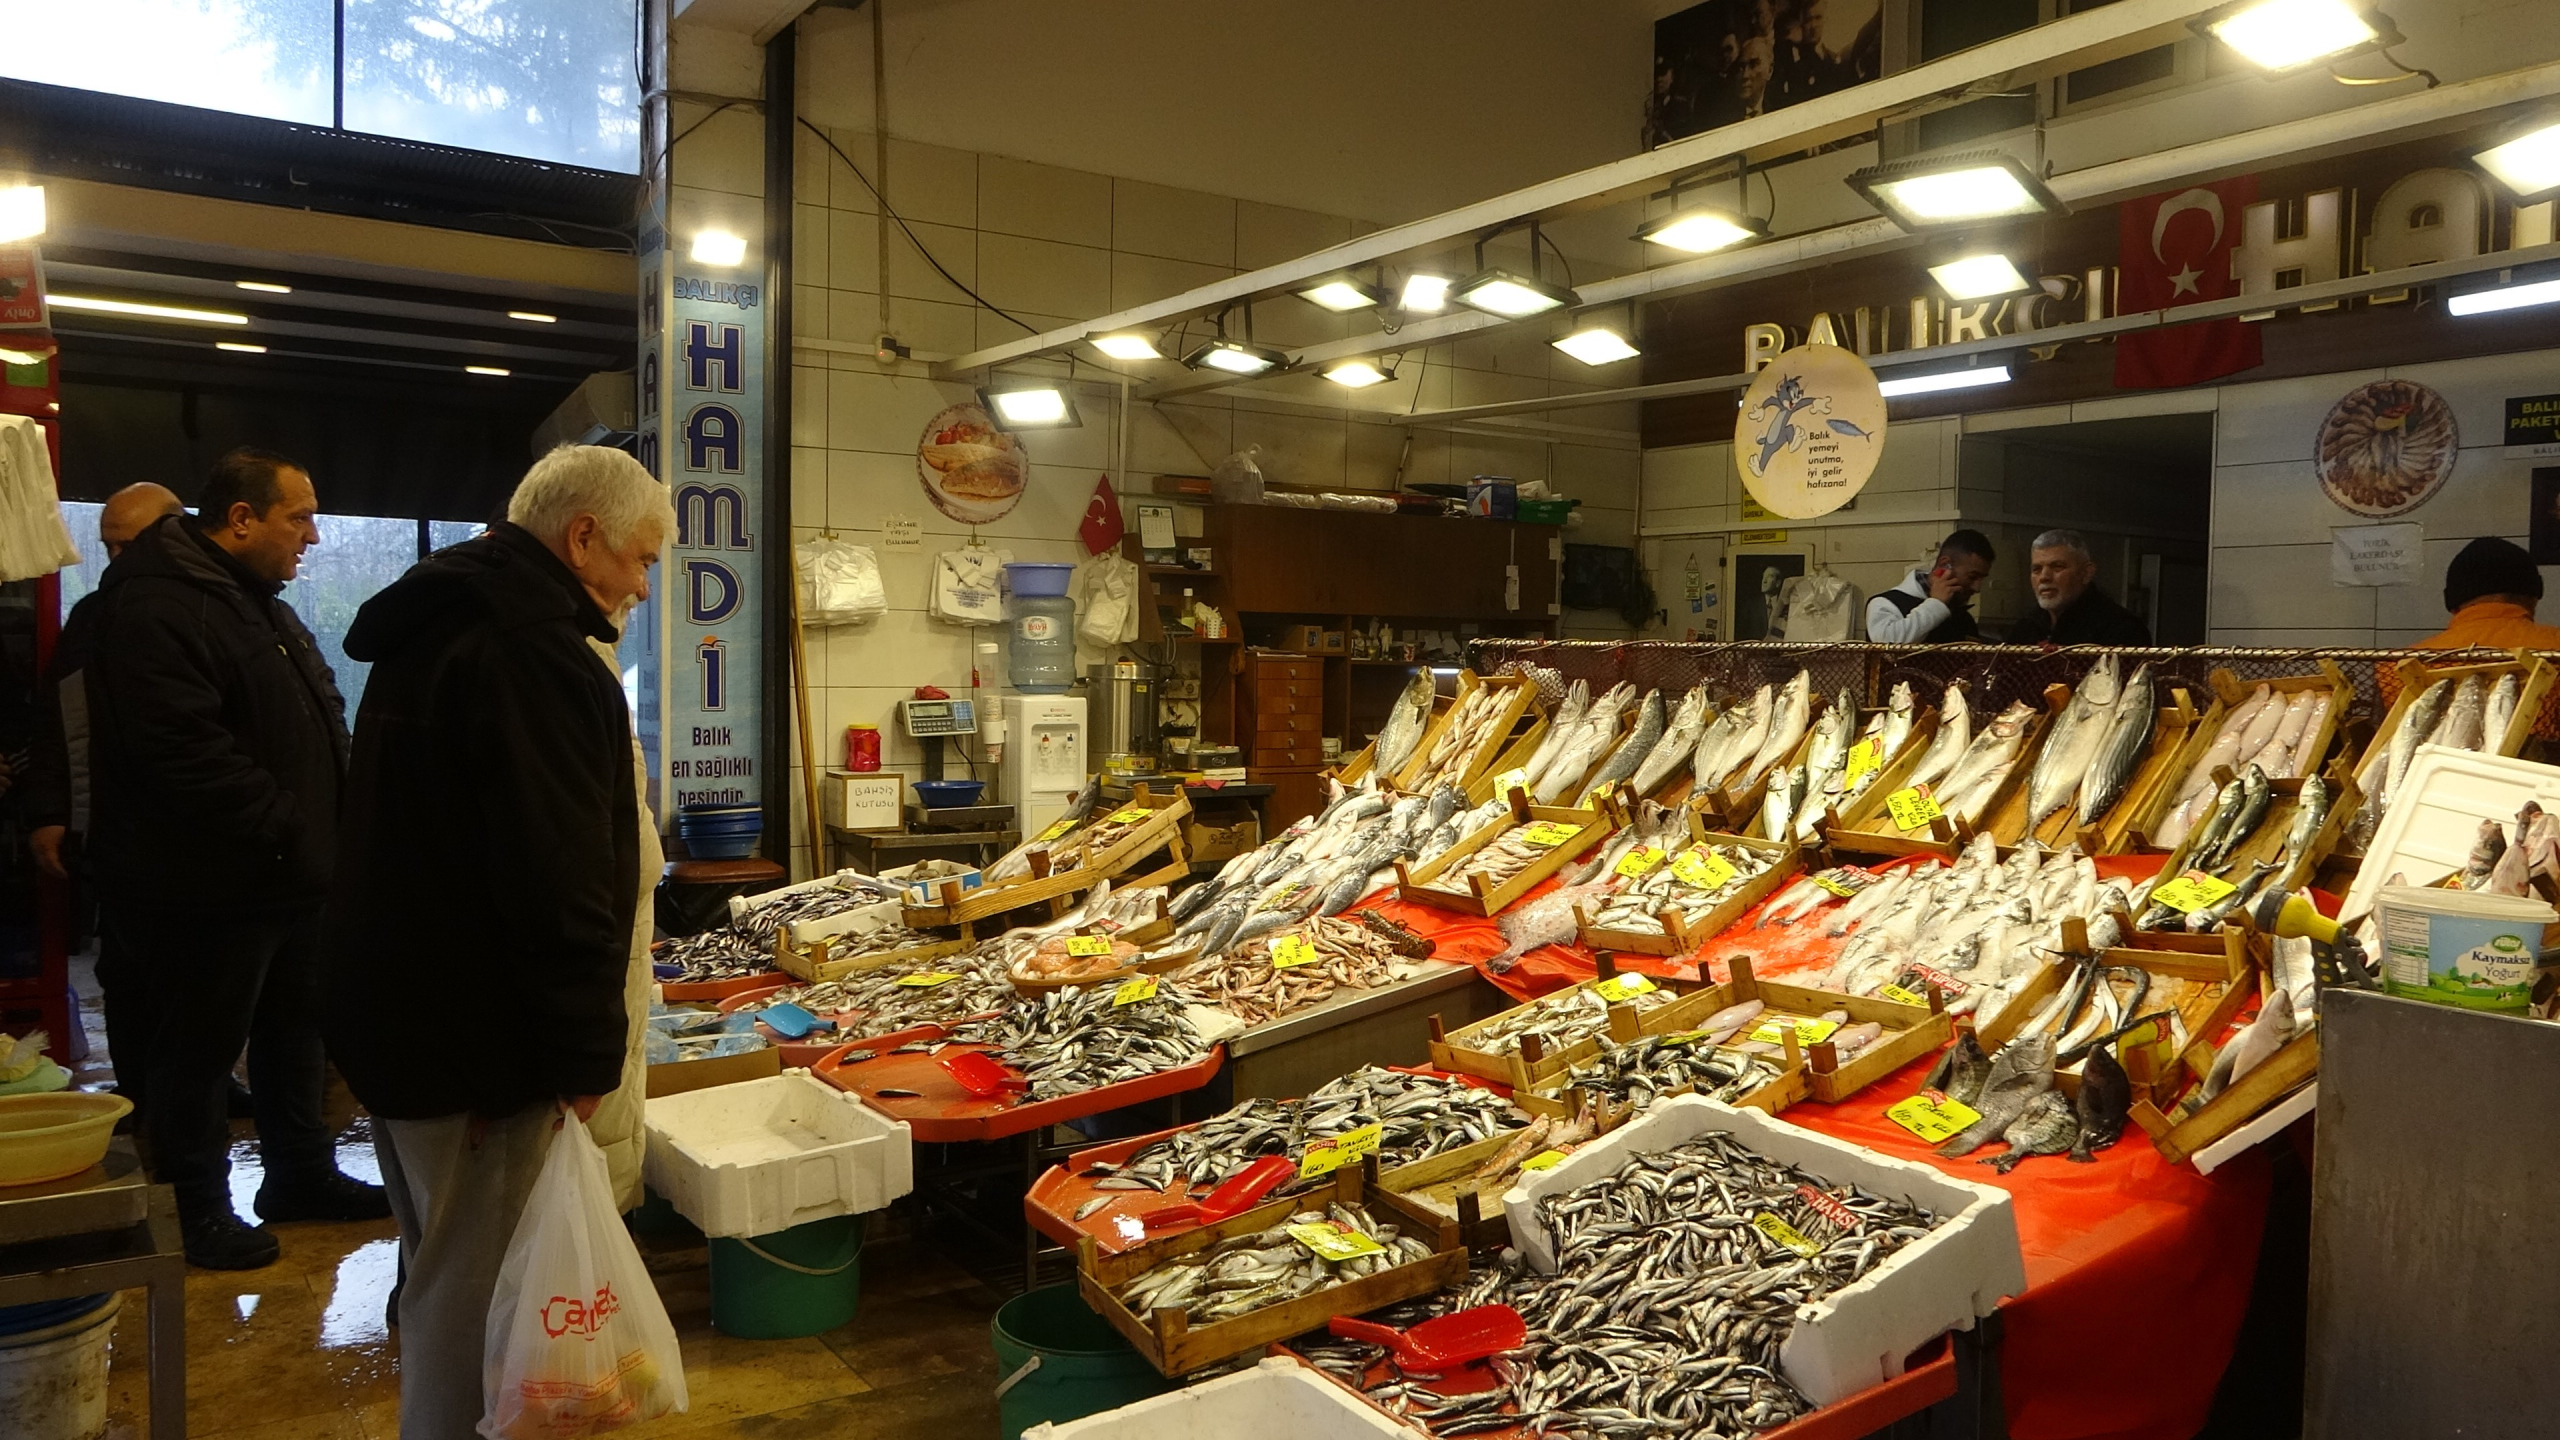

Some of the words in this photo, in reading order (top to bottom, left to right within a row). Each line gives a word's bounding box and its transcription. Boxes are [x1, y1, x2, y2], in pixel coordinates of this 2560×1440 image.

[2230, 166, 2560, 322] HA
[673, 276, 758, 309] BALIKÇI
[1809, 432, 1830, 440] Balık
[1808, 442, 1839, 453] yemeyi
[1808, 456, 1844, 465] unutma,
[1807, 468, 1817, 477] iyi
[1822, 467, 1842, 478] gelir
[1807, 478, 1847, 489] hafızana!
[672, 319, 754, 712] HAMDİ
[692, 727, 731, 747] Balık
[672, 761, 690, 778] en
[695, 757, 752, 779] sağlıklı
[855, 786, 894, 796] BAHŞİŞ
[855, 800, 894, 808] KUTUSU
[2485, 966, 2521, 980] Yoğurt
